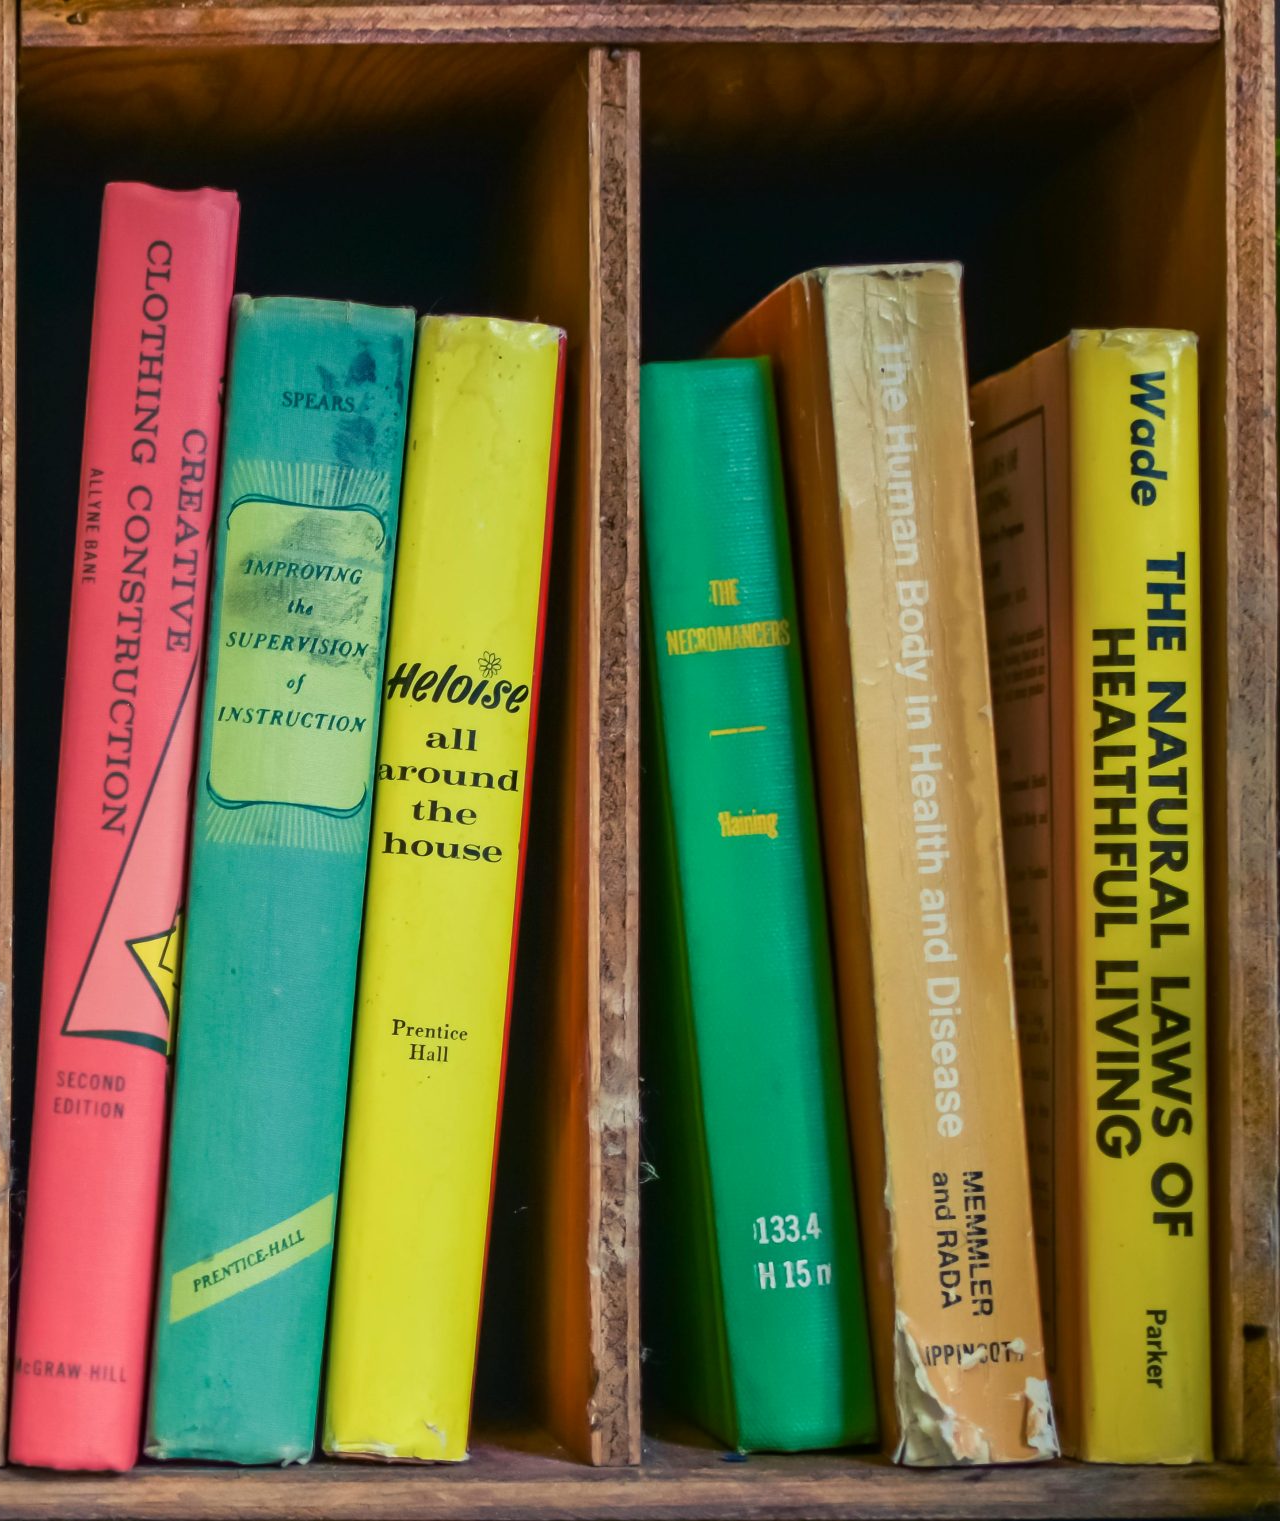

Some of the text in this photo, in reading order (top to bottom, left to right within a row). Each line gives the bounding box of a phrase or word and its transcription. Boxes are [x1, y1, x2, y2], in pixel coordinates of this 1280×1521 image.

[282, 390, 355, 413] SPEARS
[1130, 370, 1166, 506] Wade
[81, 468, 104, 585] ALLYNE BANE
[100, 240, 173, 835] CLOTHING CONSTRUCTION
[166, 429, 208, 653] CREATIVE
[244, 559, 363, 587] IMPROVING
[287, 598, 313, 617] the
[709, 579, 740, 606] THE
[225, 631, 370, 658] SUPERVISION
[666, 619, 790, 655] NECROMANCERS
[286, 673, 305, 694] of
[386, 662, 529, 714] Heloise
[218, 705, 366, 735] INSTRUCTION
[425, 727, 478, 752] all
[875, 342, 963, 1138] The Human Body in Health and Disease
[378, 762, 519, 793] around
[411, 798, 478, 826] the
[718, 809, 778, 839] Haining
[382, 832, 503, 863] house
[1092, 628, 1141, 1160] HEALTHFUL LIVING
[1146, 551, 1192, 1237] THE NATURAL LAWS OF
[391, 1019, 468, 1041] Prentice
[408, 1042, 449, 1063] Hall
[56, 1071, 126, 1093] SECOND
[53, 1097, 126, 1119] EDITION
[756, 1212, 822, 1245] 133.4
[932, 1172, 962, 1309] and RADA
[962, 1170, 994, 1317] MEMMLER
[193, 1229, 305, 1292] PRENTICE-HALL
[758, 1261, 776, 1289] H
[783, 1259, 811, 1289] 15
[924, 1341, 1024, 1366] IPPINCOT
[1146, 1309, 1167, 1389] Parker
